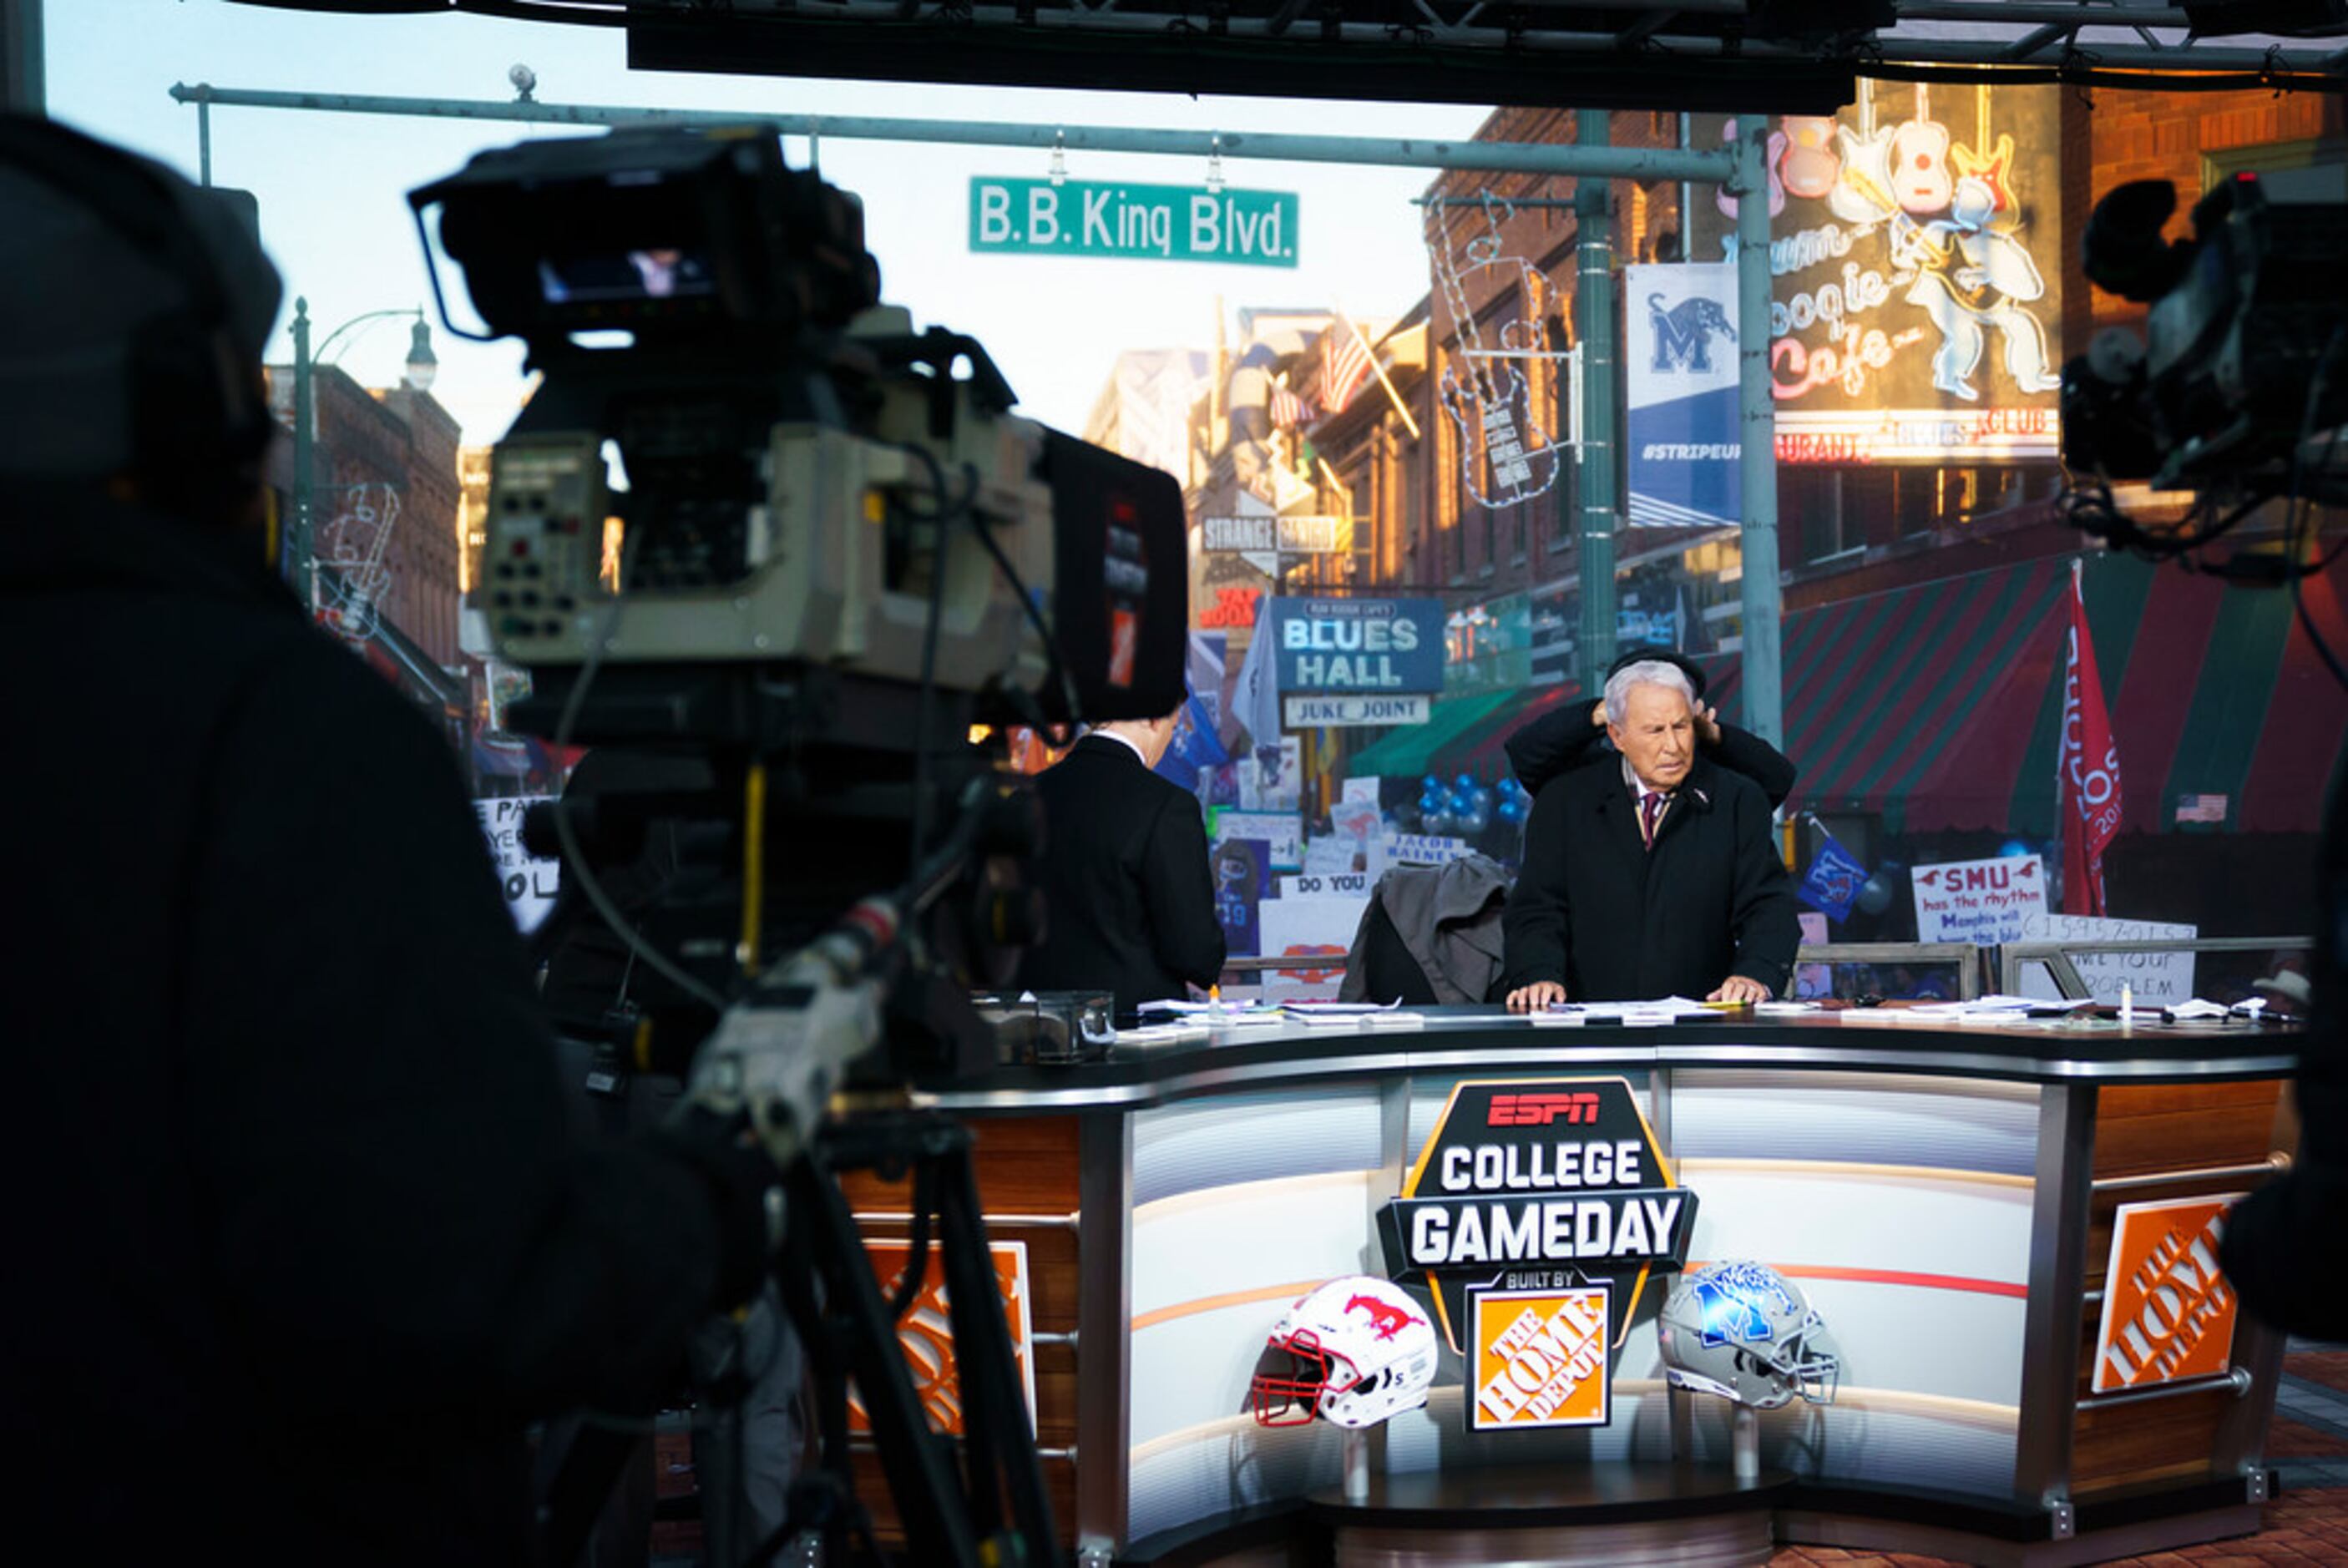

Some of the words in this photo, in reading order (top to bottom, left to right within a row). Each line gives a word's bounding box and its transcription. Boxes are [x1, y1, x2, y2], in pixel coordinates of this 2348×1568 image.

[979, 185, 1072, 245] B.B.
[1084, 189, 1171, 257] King
[1189, 194, 1293, 258] Blvd.
[1205, 518, 1274, 550] STRANGE
[1283, 617, 1419, 652] BLUES
[1297, 655, 1402, 686] HALL
[1297, 702, 1346, 721] JUKE
[1360, 699, 1417, 720] JOINT
[1298, 878, 1322, 893] DO
[1329, 876, 1365, 891] YOU
[1944, 864, 2010, 893] SMU
[1923, 898, 1949, 912] has
[1954, 896, 1978, 908] the
[1985, 888, 2040, 908] rhythm
[1486, 1093, 1601, 1126] ESPN
[1440, 1141, 1642, 1192] COLLEGE
[1411, 1197, 1683, 1265] GAMEDAY
[1506, 1272, 1551, 1290] BUILT
[1552, 1271, 1575, 1287] BY
[1488, 1306, 1546, 1363] THE
[1479, 1295, 1604, 1423] HOME
[1526, 1338, 1604, 1421] DEPOT
